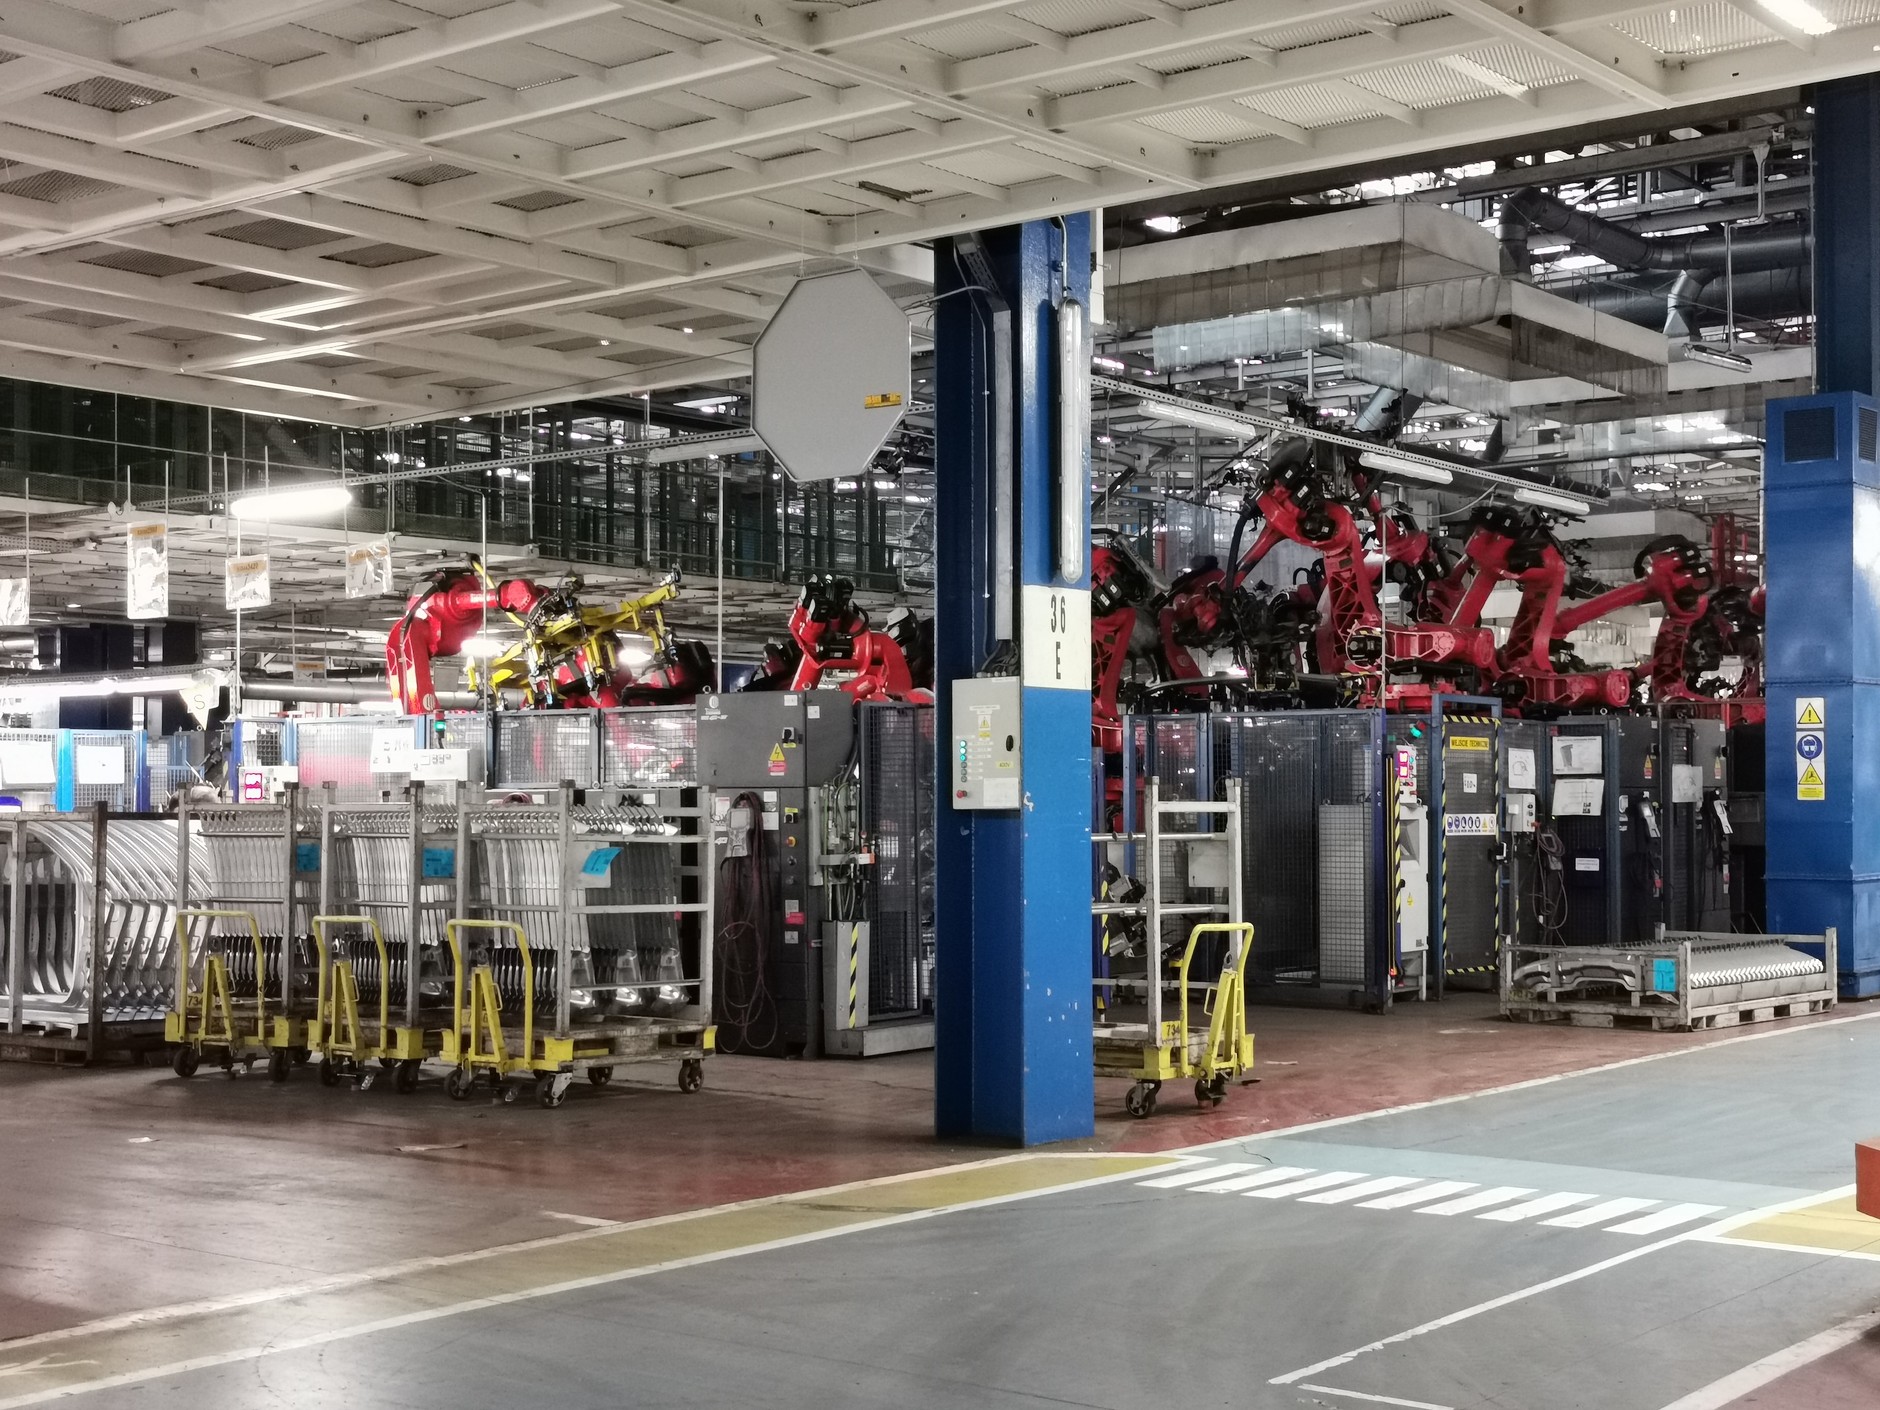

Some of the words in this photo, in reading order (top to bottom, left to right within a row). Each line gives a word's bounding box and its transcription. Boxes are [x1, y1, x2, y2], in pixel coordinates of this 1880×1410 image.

[1051, 594, 1066, 634] 36
[1056, 641, 1062, 680] E
[193, 694, 206, 710] S
